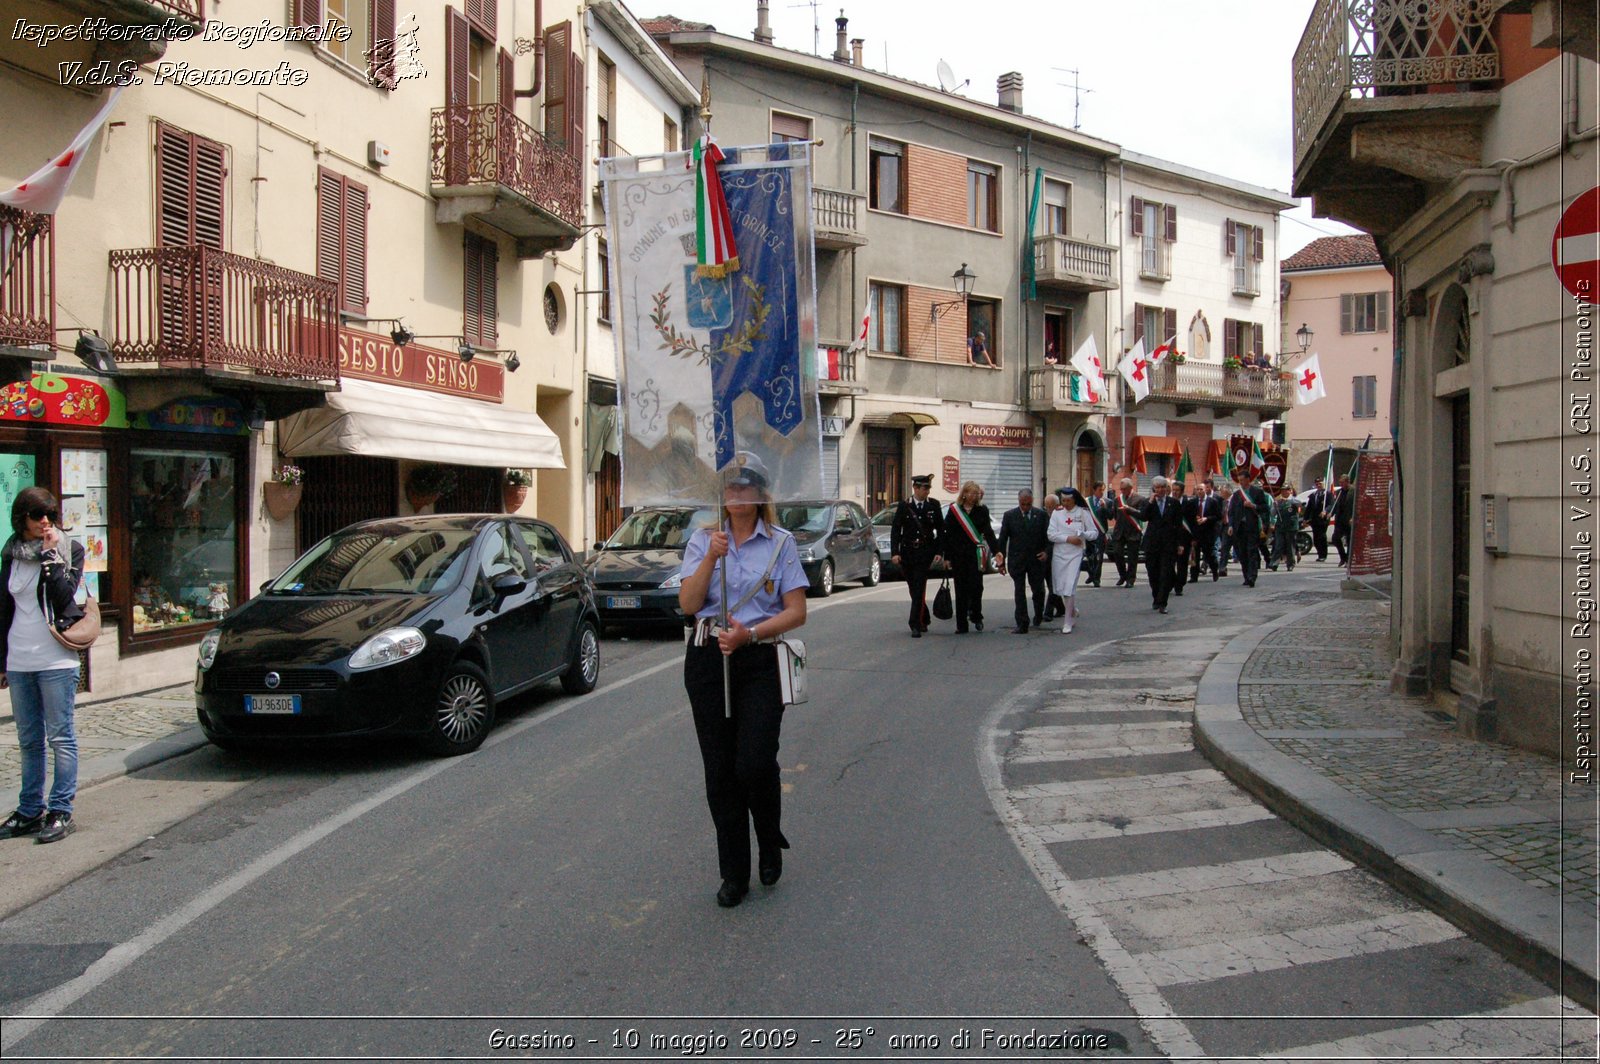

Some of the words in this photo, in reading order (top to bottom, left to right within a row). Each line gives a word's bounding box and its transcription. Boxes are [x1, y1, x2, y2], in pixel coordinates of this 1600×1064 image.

[629, 221, 667, 263] COMUNE
[667, 213, 680, 229] DI
[735, 209, 785, 254] TORINESE
[339, 334, 404, 377] SESTO
[426, 354, 478, 391] SENSO
[966, 424, 997, 437] CHOCO
[999, 425, 1031, 438] SHOPPE
